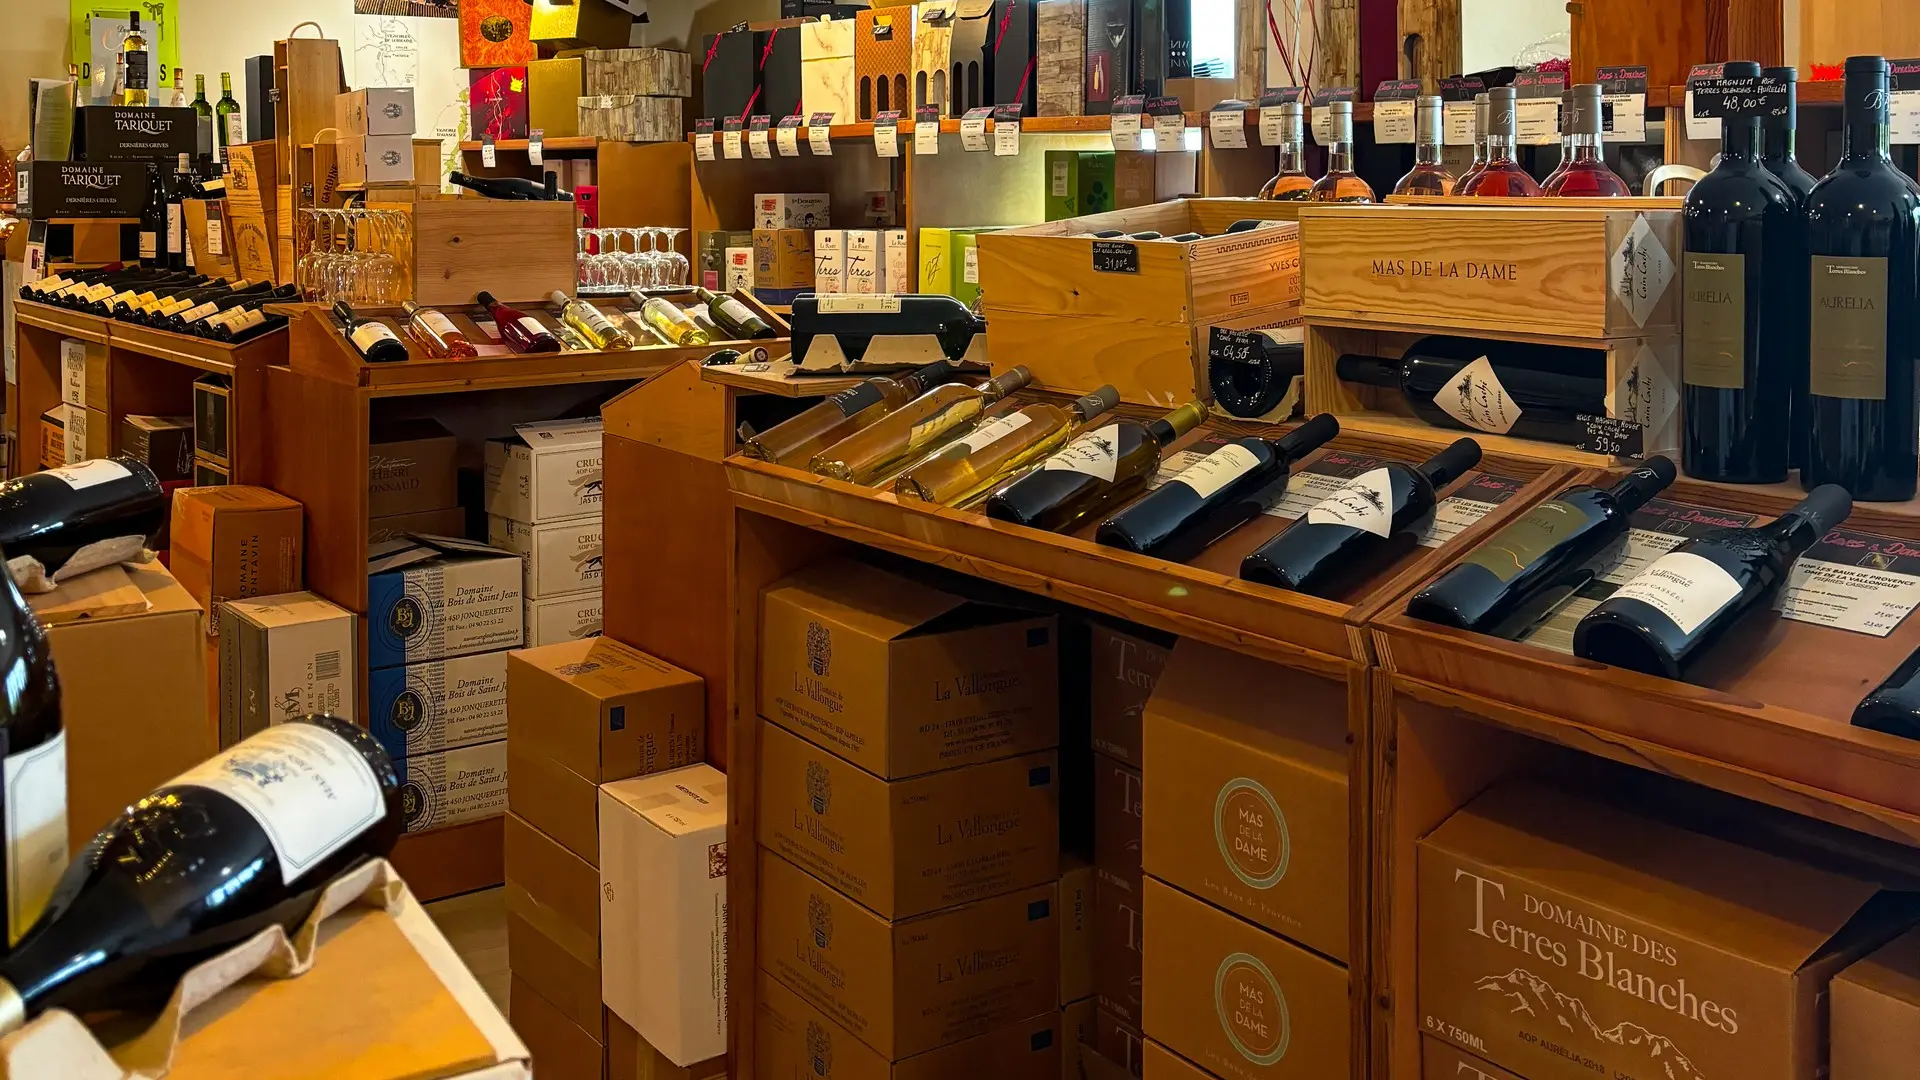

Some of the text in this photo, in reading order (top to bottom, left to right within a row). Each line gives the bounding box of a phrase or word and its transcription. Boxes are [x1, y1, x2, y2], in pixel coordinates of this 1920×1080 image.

[1716, 77, 1754, 86] MAGNUM
[115, 120, 173, 135] TARIQUET
[62, 166, 104, 174] DOMAINE
[61, 174, 121, 189] TARIQUET
[1270, 260, 1290, 271] YVES
[1372, 260, 1517, 280] MAS DE LA DAME
[1820, 296, 1875, 310] AURELIA
[576, 459, 595, 468] CRU
[369, 477, 420, 493] ONNAUD
[578, 534, 597, 544] CRU
[251, 535, 259, 595] ONTAVIN
[1650, 569, 1692, 588] Vallongue
[1798, 563, 1817, 571] AOP
[1817, 564, 1833, 572] LES
[1833, 567, 1856, 576] BAUX
[1870, 575, 1917, 586] PROVENCE
[1812, 576, 1845, 585] PIERRES
[1849, 576, 1900, 589] VALLONGUE
[456, 585, 494, 596] Domaine
[448, 598, 465, 607] Bois
[466, 595, 476, 604] de
[477, 593, 500, 603] Saint
[499, 591, 519, 602] Jean
[449, 606, 514, 622] 450 JONQUERETTES
[577, 608, 597, 619] CRU
[457, 677, 494, 689] Domaine
[934, 671, 1019, 702] La Vallongue
[449, 690, 466, 700] Bois
[467, 688, 476, 697] de
[478, 685, 499, 696] Saint
[794, 672, 844, 713] La Vallongue
[449, 706, 461, 714] 450
[458, 767, 495, 780] Domaine
[449, 780, 466, 791] Bois
[468, 778, 477, 787] de
[478, 775, 500, 786] Saint
[449, 796, 462, 805] 450
[1239, 808, 1263, 827] MAS
[794, 808, 845, 854] La Vallongue
[937, 813, 1021, 845] La Vallongue
[1240, 824, 1263, 842] DE LA
[1235, 837, 1268, 861] DAME
[1523, 893, 1678, 967] DOMAINE DES
[1454, 868, 1739, 1035] Terres Blanches
[796, 938, 846, 990] La Vallongue
[937, 948, 1020, 984] La Vallongue
[1239, 982, 1264, 1004] MAS
[1240, 998, 1263, 1019] DE LA
[1235, 1011, 1268, 1038] DAME
[1426, 1016, 1489, 1053] 6 X 750ML
[1518, 1030, 1538, 1044] AOP
[1540, 1039, 1582, 1064] AURELIA
